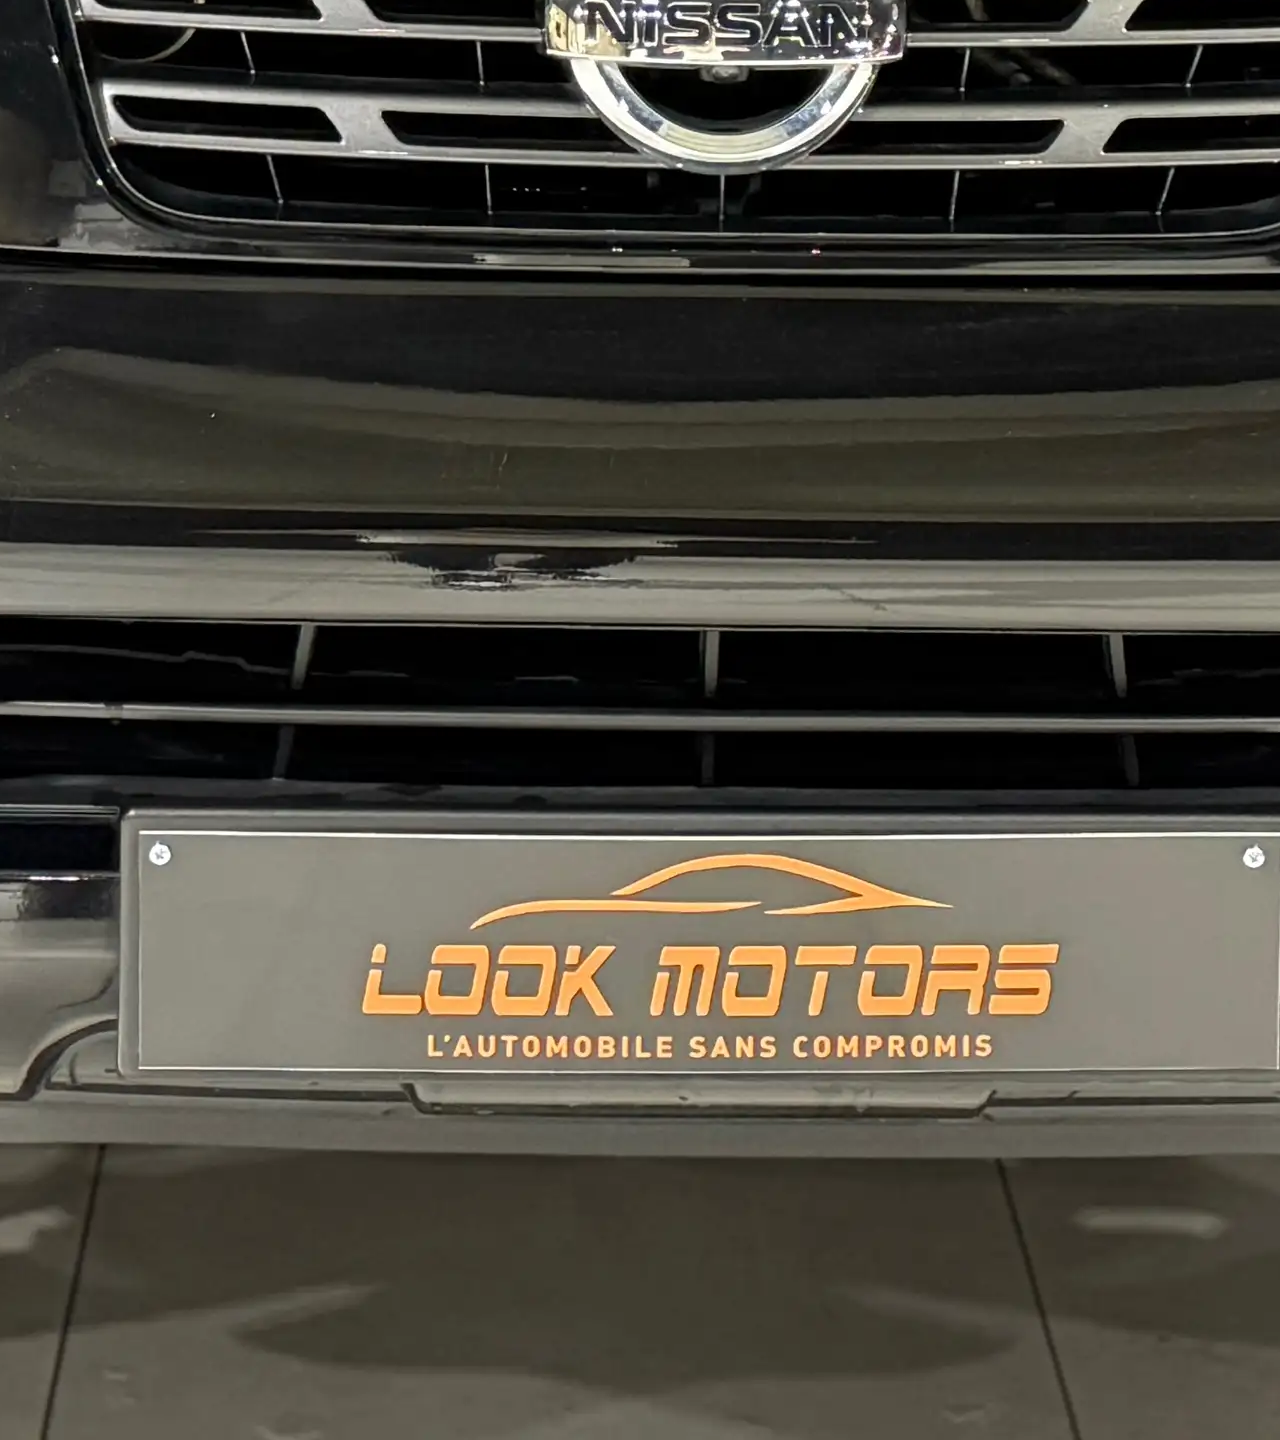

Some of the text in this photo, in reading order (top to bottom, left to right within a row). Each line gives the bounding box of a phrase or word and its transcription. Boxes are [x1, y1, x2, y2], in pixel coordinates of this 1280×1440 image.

[361, 943, 1060, 1018] LOOK MOTORS
[427, 1034, 993, 1061] L'AUTOMOBILE SANS COMPROMIS
